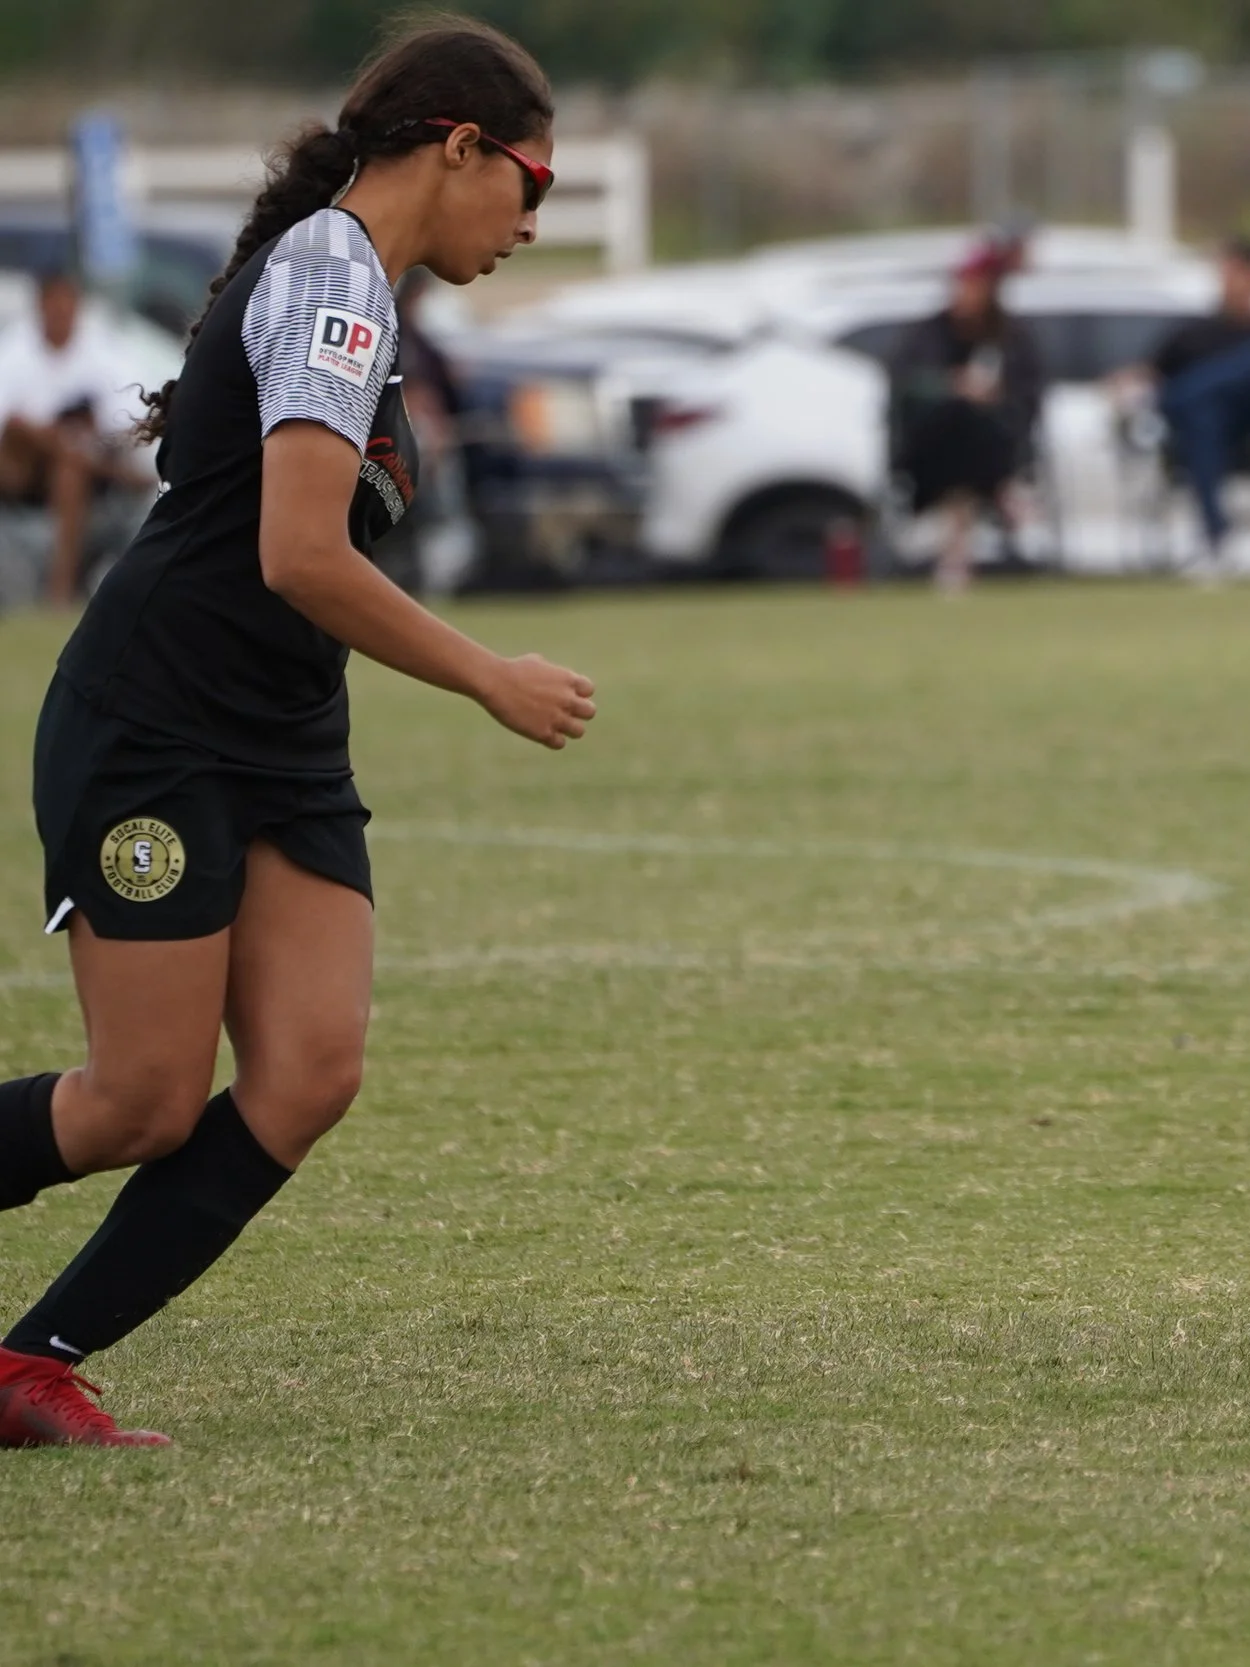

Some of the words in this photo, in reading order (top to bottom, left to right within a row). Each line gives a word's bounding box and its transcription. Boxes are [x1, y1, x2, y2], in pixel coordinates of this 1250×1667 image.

[321, 315, 373, 356] DP
[109, 821, 145, 845] SOCAL
[148, 822, 177, 847] ELITE
[104, 865, 154, 899] FOOTBALL
[155, 868, 179, 895] CLUB
